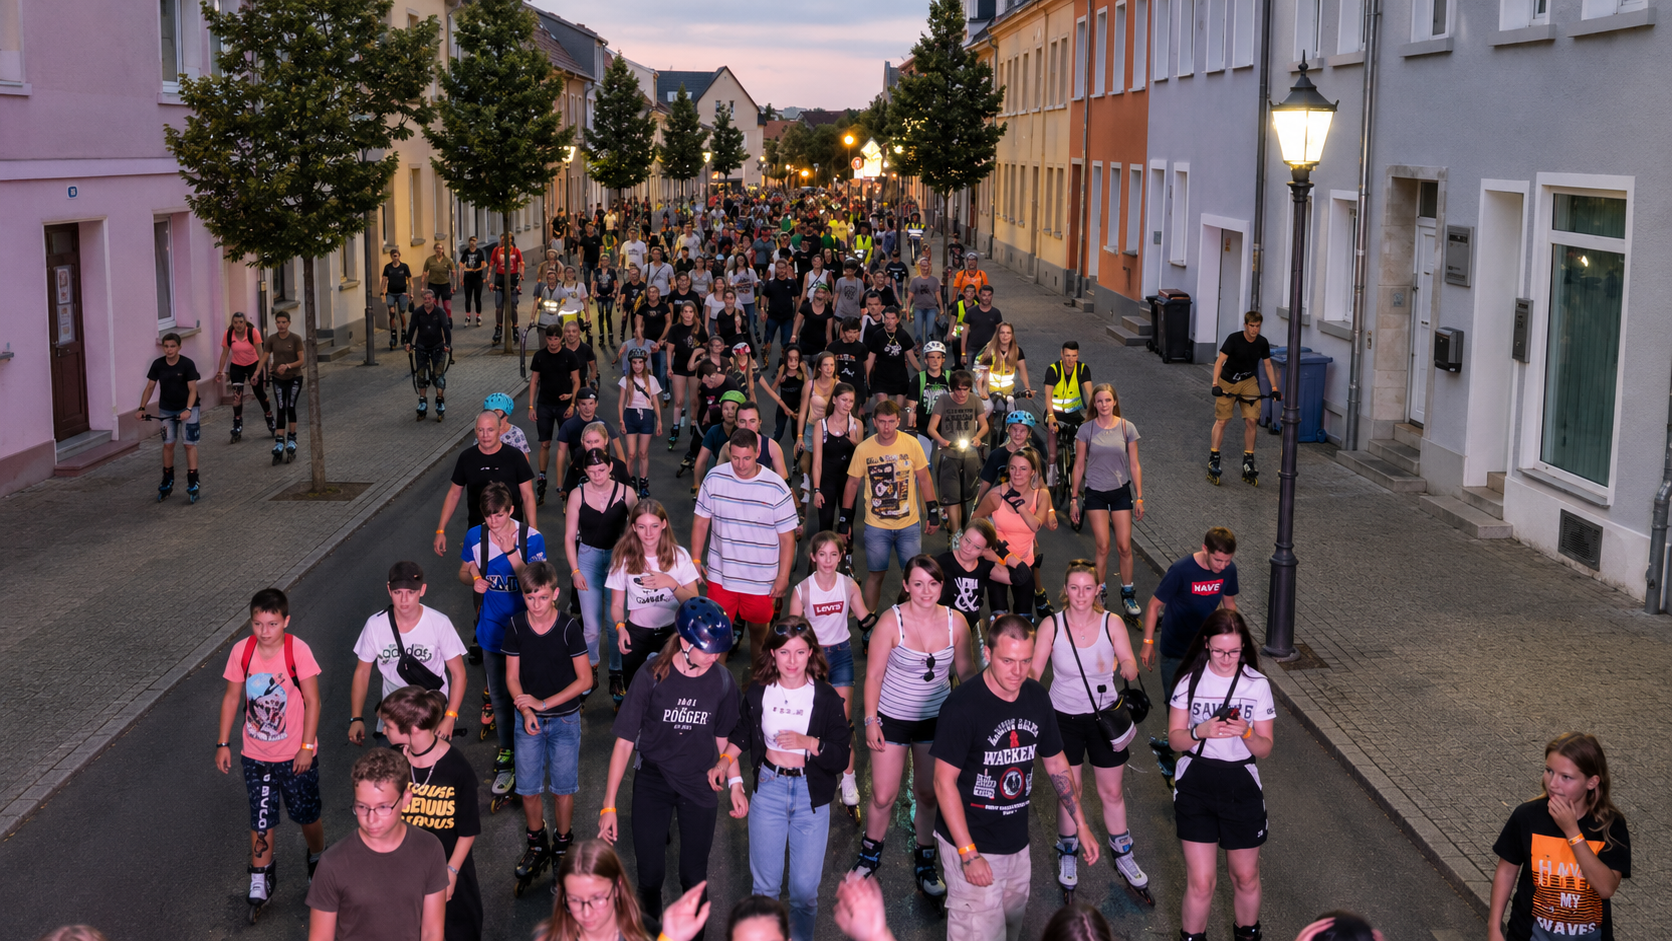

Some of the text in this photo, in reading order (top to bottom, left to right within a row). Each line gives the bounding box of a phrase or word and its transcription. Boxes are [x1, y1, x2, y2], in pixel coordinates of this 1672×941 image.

[983, 743, 1037, 766] WACKEN
[1560, 892, 1580, 909] MY
[1536, 916, 1597, 936] WAVES
